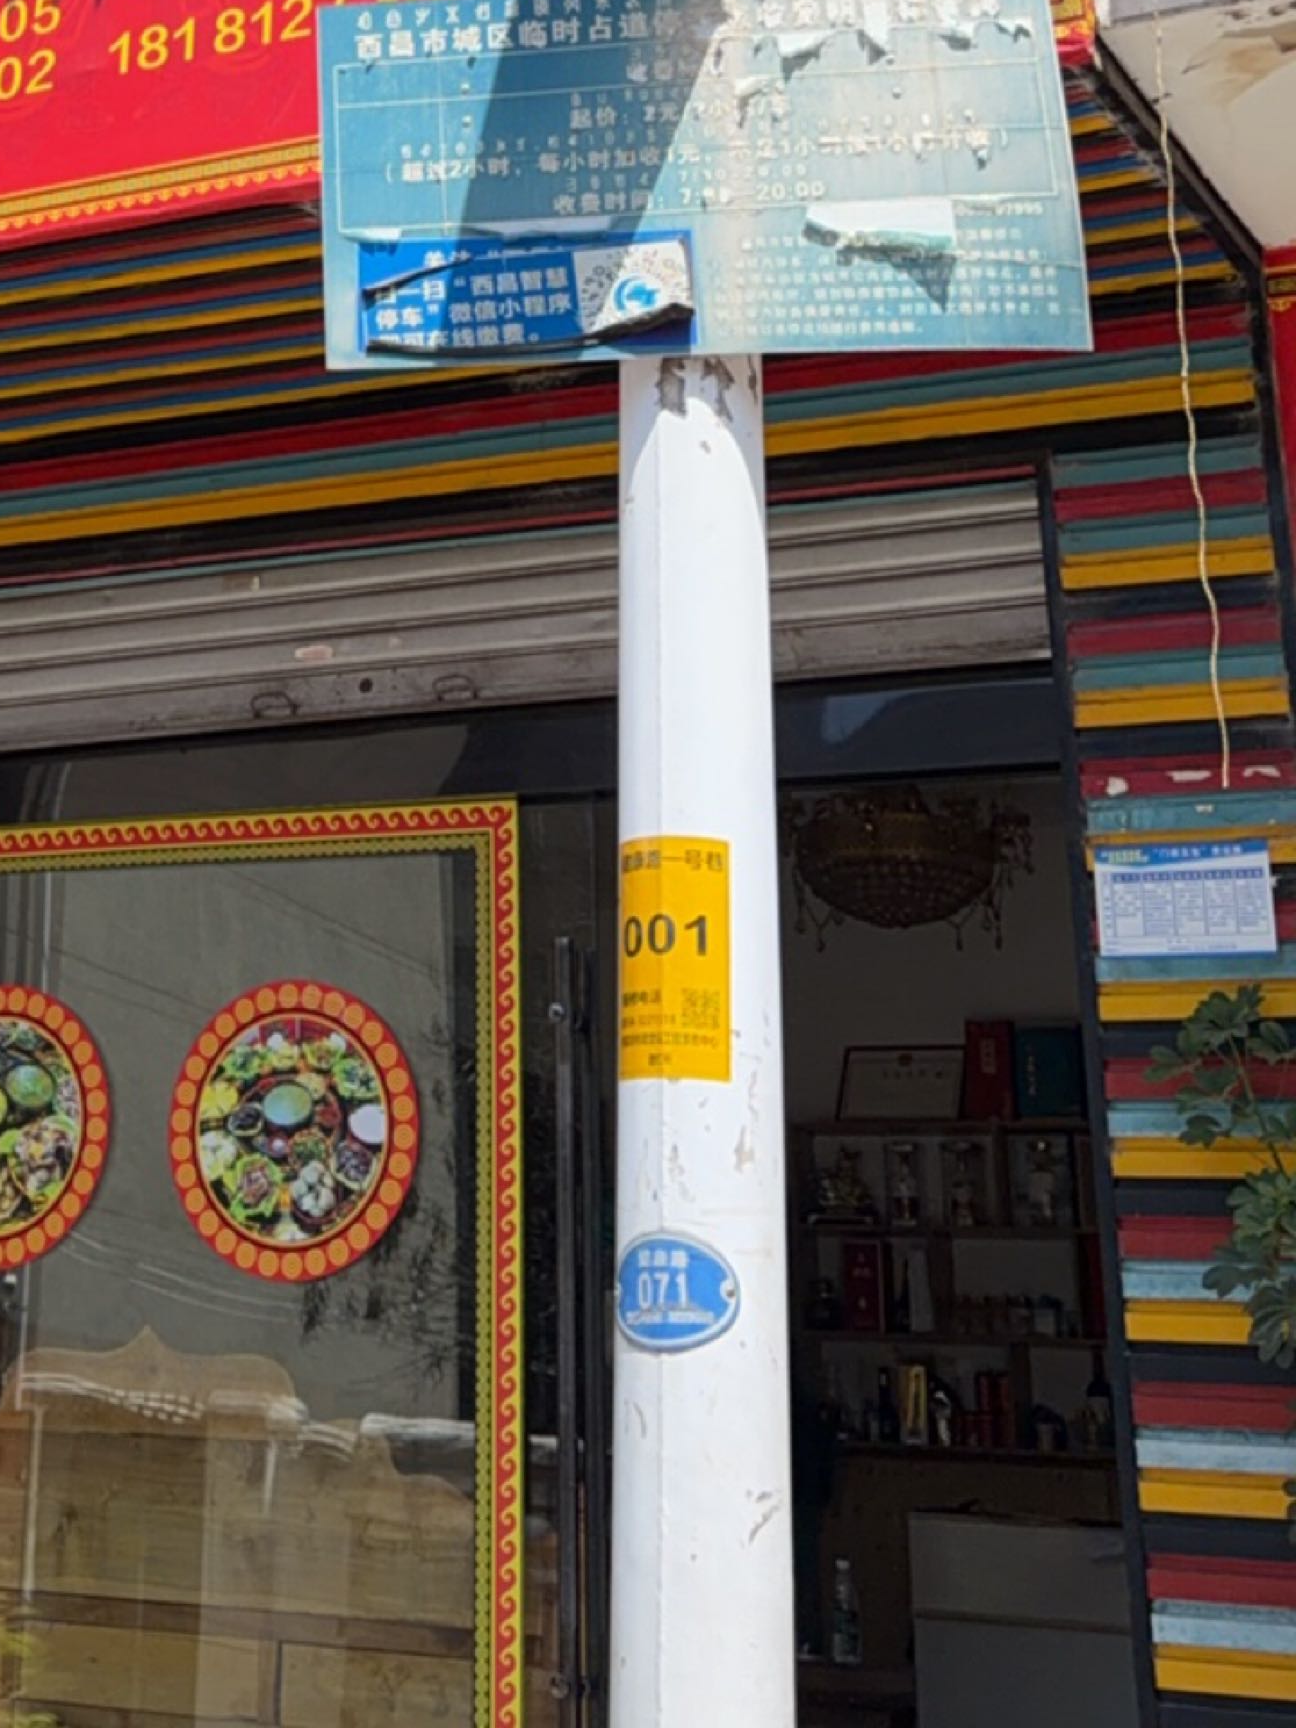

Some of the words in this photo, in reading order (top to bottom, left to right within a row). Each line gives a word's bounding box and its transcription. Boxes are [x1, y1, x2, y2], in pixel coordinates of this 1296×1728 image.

[108, 17, 197, 75] 181
[623, 913, 709, 959] 001
[638, 1271, 689, 1311] 071
